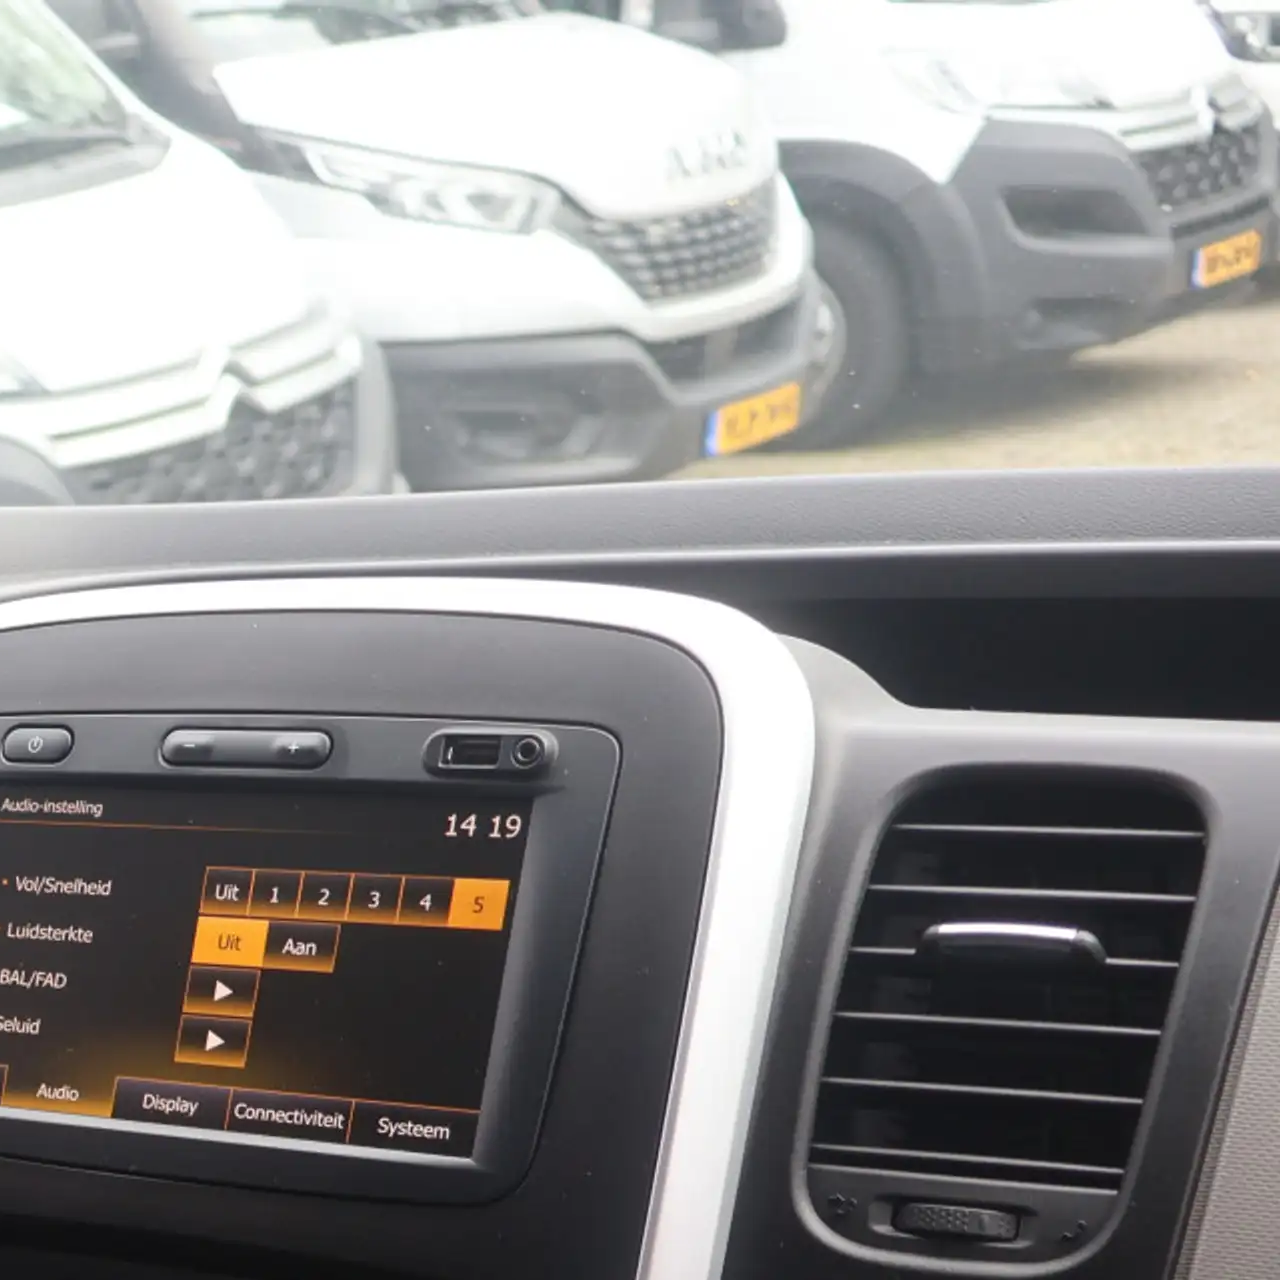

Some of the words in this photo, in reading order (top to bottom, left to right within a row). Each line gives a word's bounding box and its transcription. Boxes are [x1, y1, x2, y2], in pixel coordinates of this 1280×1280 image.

[0, 797, 104, 818] Audio-instelling
[445, 813, 477, 838] 14
[489, 814, 522, 839] 19
[15, 875, 112, 897] Vol/Snelheid
[215, 884, 240, 902] Uit
[269, 886, 280, 904] 1
[317, 888, 330, 906] 2
[367, 891, 381, 909] 3
[419, 893, 432, 912] 4
[471, 896, 485, 914] 5
[7, 922, 93, 944] Luidsterkte
[217, 933, 242, 952] Uit
[281, 938, 317, 957] Aan
[0, 968, 68, 990] BAL/FAD
[36, 1082, 80, 1103] Audio
[142, 1093, 199, 1118] Display
[234, 1102, 344, 1131] Connectiviteit
[377, 1117, 450, 1141] Systeem
